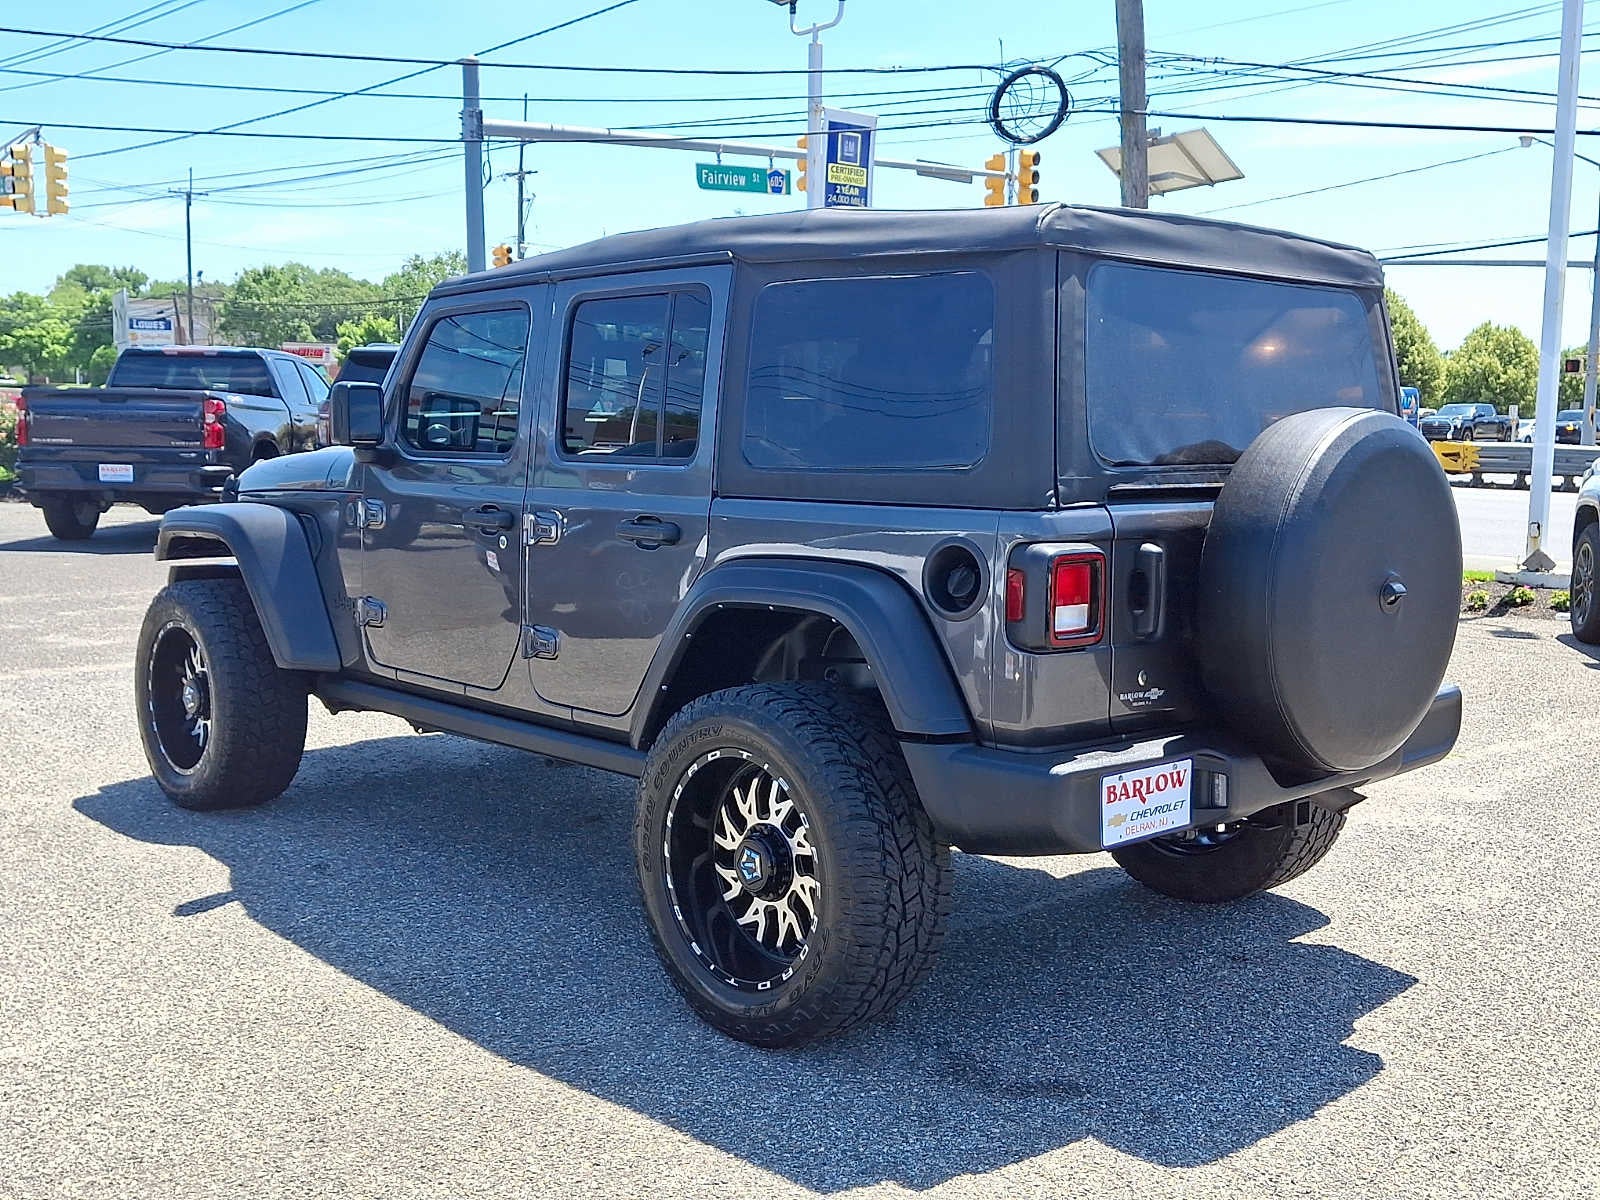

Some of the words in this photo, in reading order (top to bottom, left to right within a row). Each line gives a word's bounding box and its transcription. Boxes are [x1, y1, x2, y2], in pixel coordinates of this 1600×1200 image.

[701, 169, 746, 186] Fairview
[751, 173, 760, 184] St
[830, 165, 865, 177] CERTIFIED
[770, 175, 783, 187] 605
[830, 174, 865, 185] PRE-OWNED
[835, 185, 841, 194] 2
[842, 185, 859, 196] YEAR
[1105, 769, 1188, 805] BARLOW
[1130, 799, 1186, 822] CHEVROLET
[1125, 822, 1158, 836] DELRAN,
[1159, 818, 1168, 827] NJ
